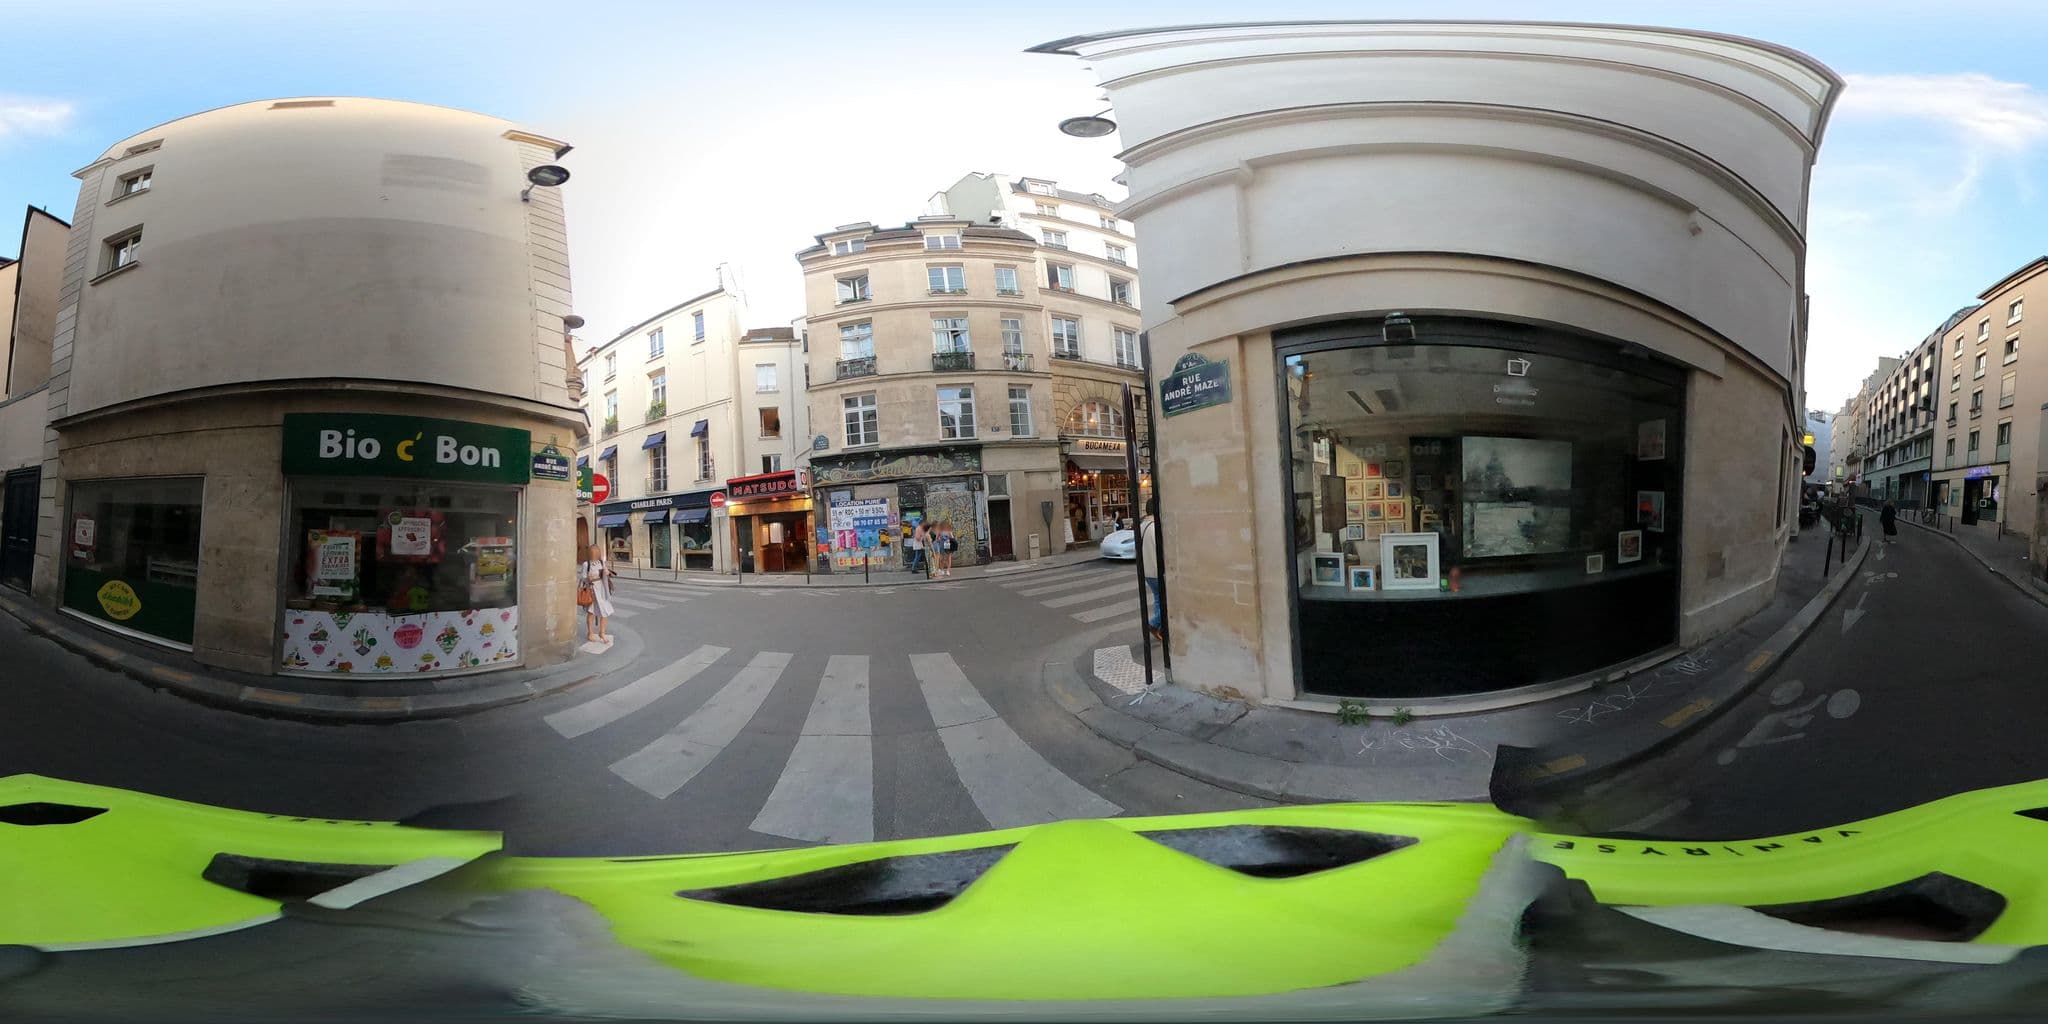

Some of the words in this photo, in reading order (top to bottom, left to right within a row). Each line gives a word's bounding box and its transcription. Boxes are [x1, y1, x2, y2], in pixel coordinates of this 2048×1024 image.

[1182, 373, 1201, 386] RUE
[1164, 385, 1192, 401] ANDRÉ
[1194, 380, 1220, 393] MAZE
[319, 428, 381, 460] Bio
[436, 435, 501, 468] Bon
[1084, 441, 1121, 451] BOCAMEXA
[733, 479, 797, 495] MATSUDO
[576, 490, 593, 498] Bon
[630, 499, 655, 509] CHARLIE
[656, 497, 673, 507] PARIS
[321, 556, 349, 565] EXTRA
